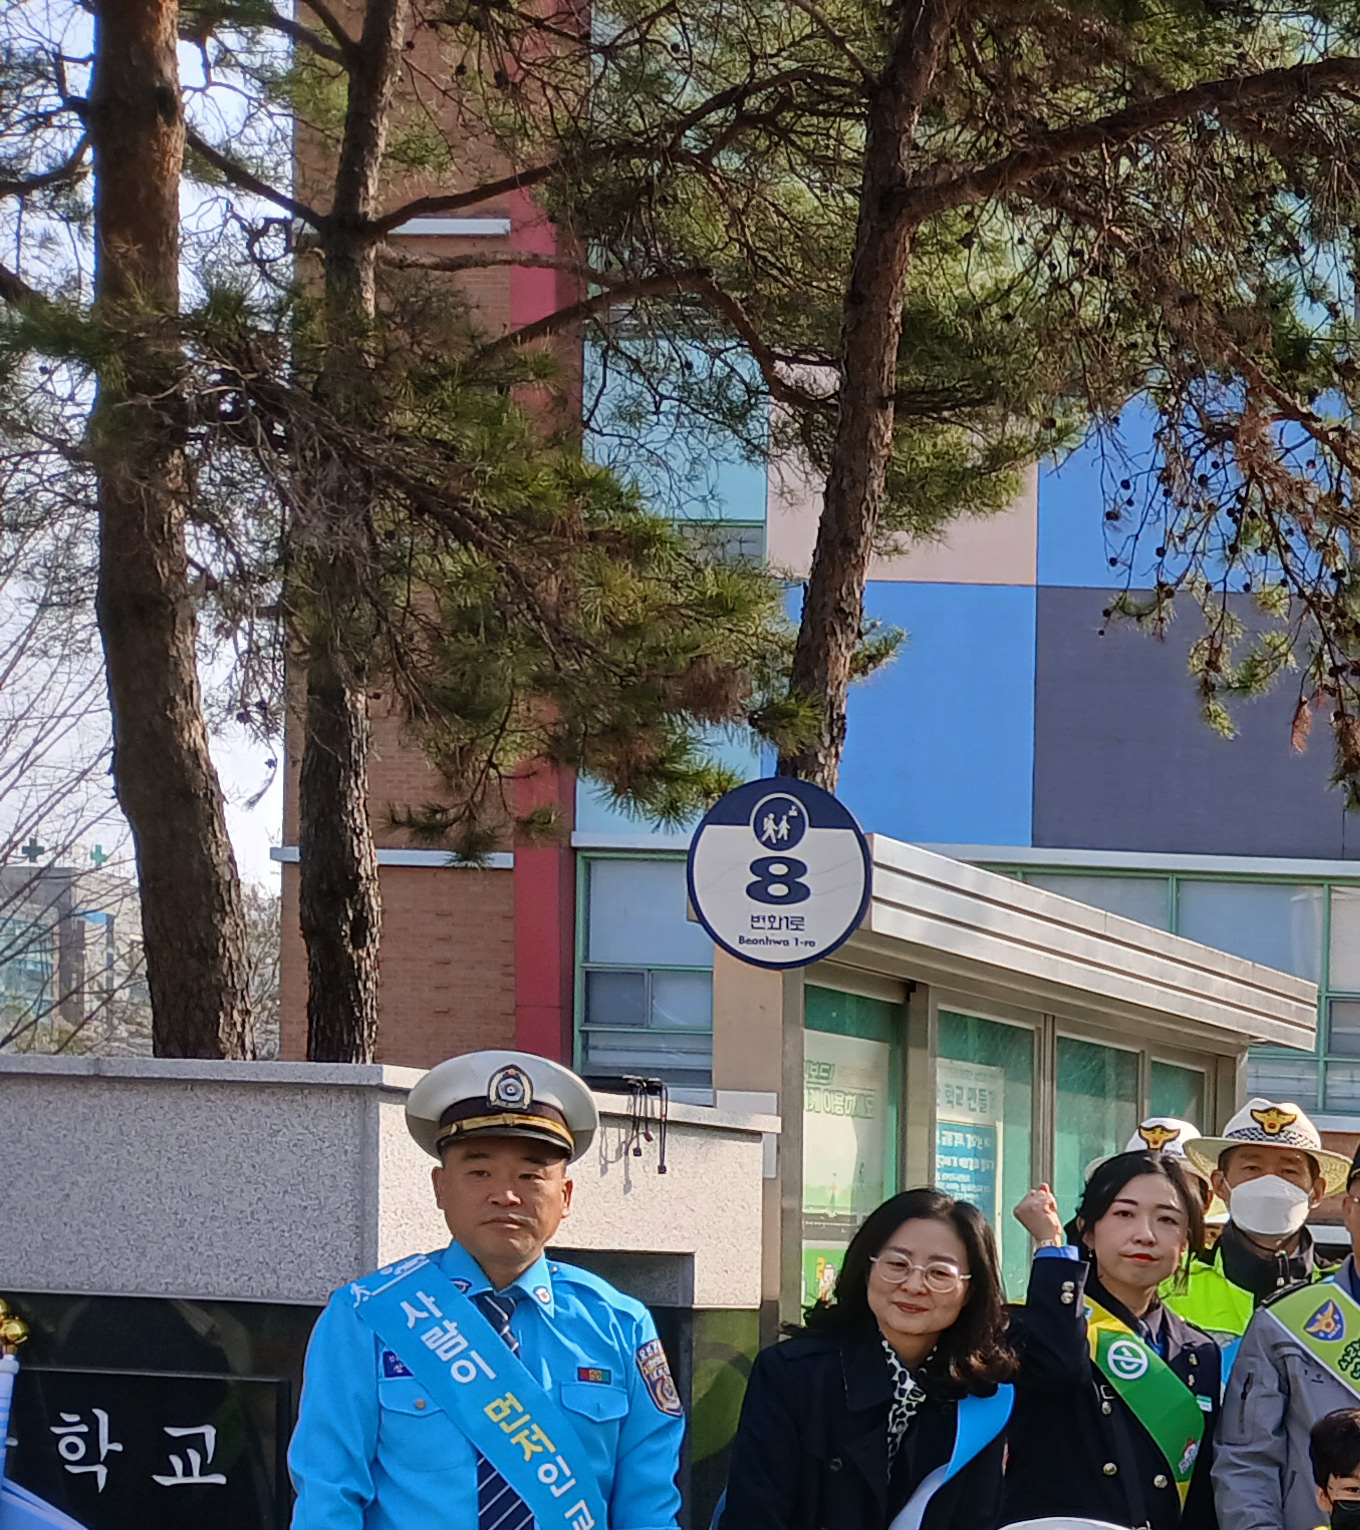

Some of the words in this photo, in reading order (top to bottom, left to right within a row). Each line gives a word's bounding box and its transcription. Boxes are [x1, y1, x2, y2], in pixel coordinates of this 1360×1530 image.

[746, 856, 811, 905] 8
[738, 935, 790, 947] Beonhwa
[794, 936, 816, 948] 1-ro
[400, 1290, 499, 1385] 사람이
[483, 1391, 579, 1498] 먼저인
